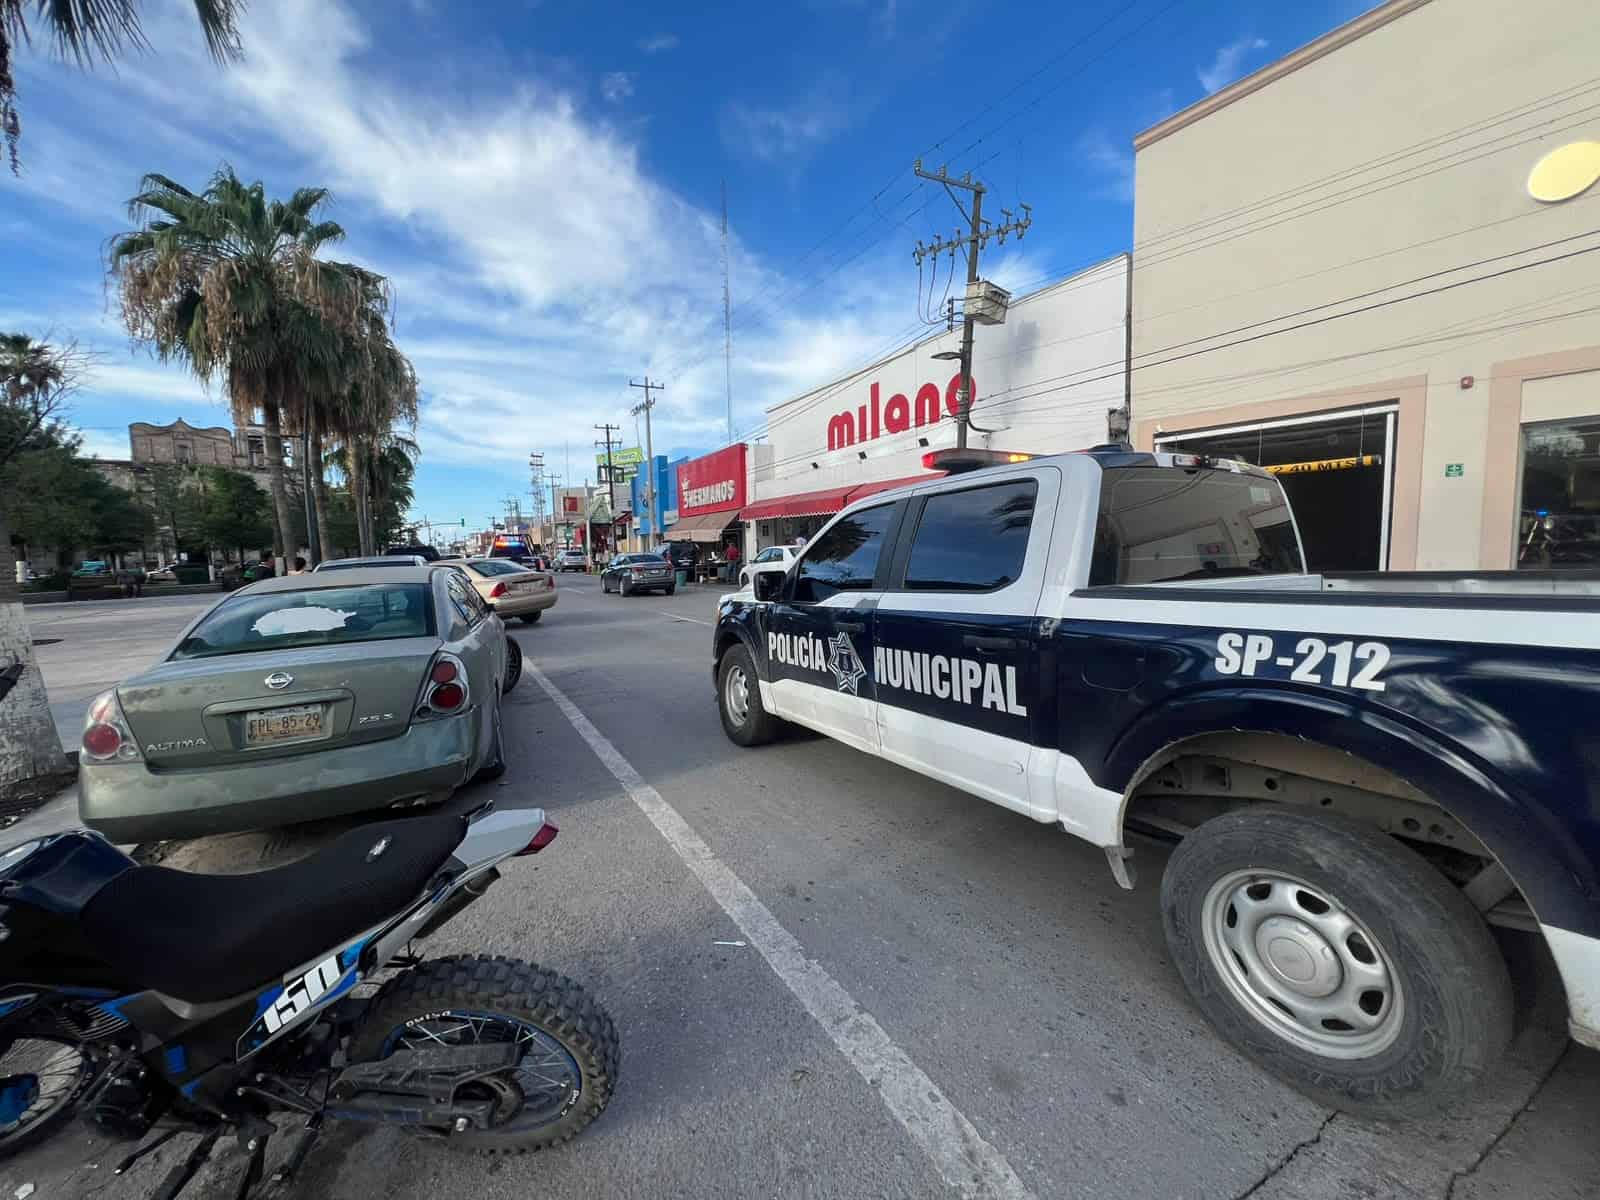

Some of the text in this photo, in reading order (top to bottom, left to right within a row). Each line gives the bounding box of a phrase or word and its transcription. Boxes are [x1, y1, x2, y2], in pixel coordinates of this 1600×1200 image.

[828, 372, 976, 451] milano
[768, 632, 827, 673] POLICÍA
[1214, 633, 1392, 691] SP-212
[146, 738, 206, 752] ALTIMA
[263, 954, 340, 1034] 150
